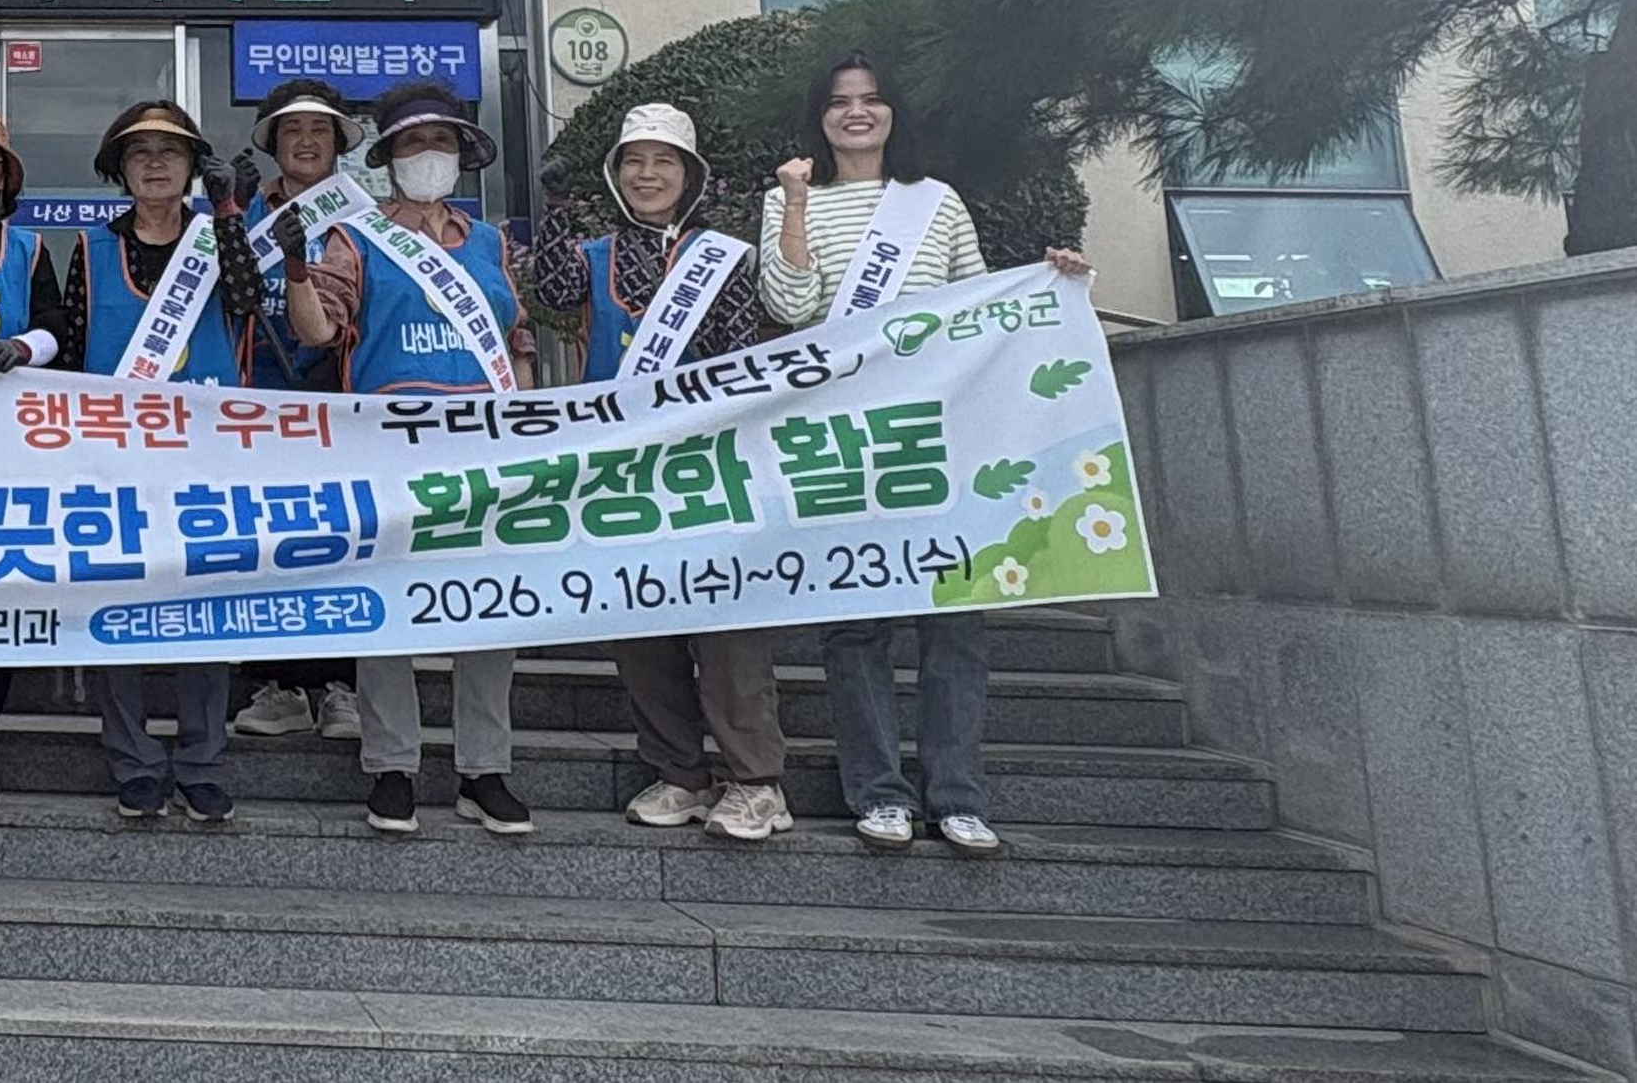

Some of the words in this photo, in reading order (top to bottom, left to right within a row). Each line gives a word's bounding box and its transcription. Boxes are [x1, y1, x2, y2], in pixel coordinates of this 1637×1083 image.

[248, 43, 466, 76] 무인민원발급창구
[567, 39, 608, 61] 108
[33, 204, 72, 222] 나산
[948, 290, 1062, 341] 함평군
[16, 391, 191, 449] 행복한
[216, 401, 332, 448] 우리
[174, 479, 379, 577] 함평!
[408, 427, 756, 553] 환경정화
[771, 400, 950, 518] 활동
[101, 601, 214, 641] 우리동네
[222, 594, 308, 636] 새단장
[312, 589, 372, 629] 주간
[408, 574, 552, 624] 2026.
[562, 571, 608, 612] 9.
